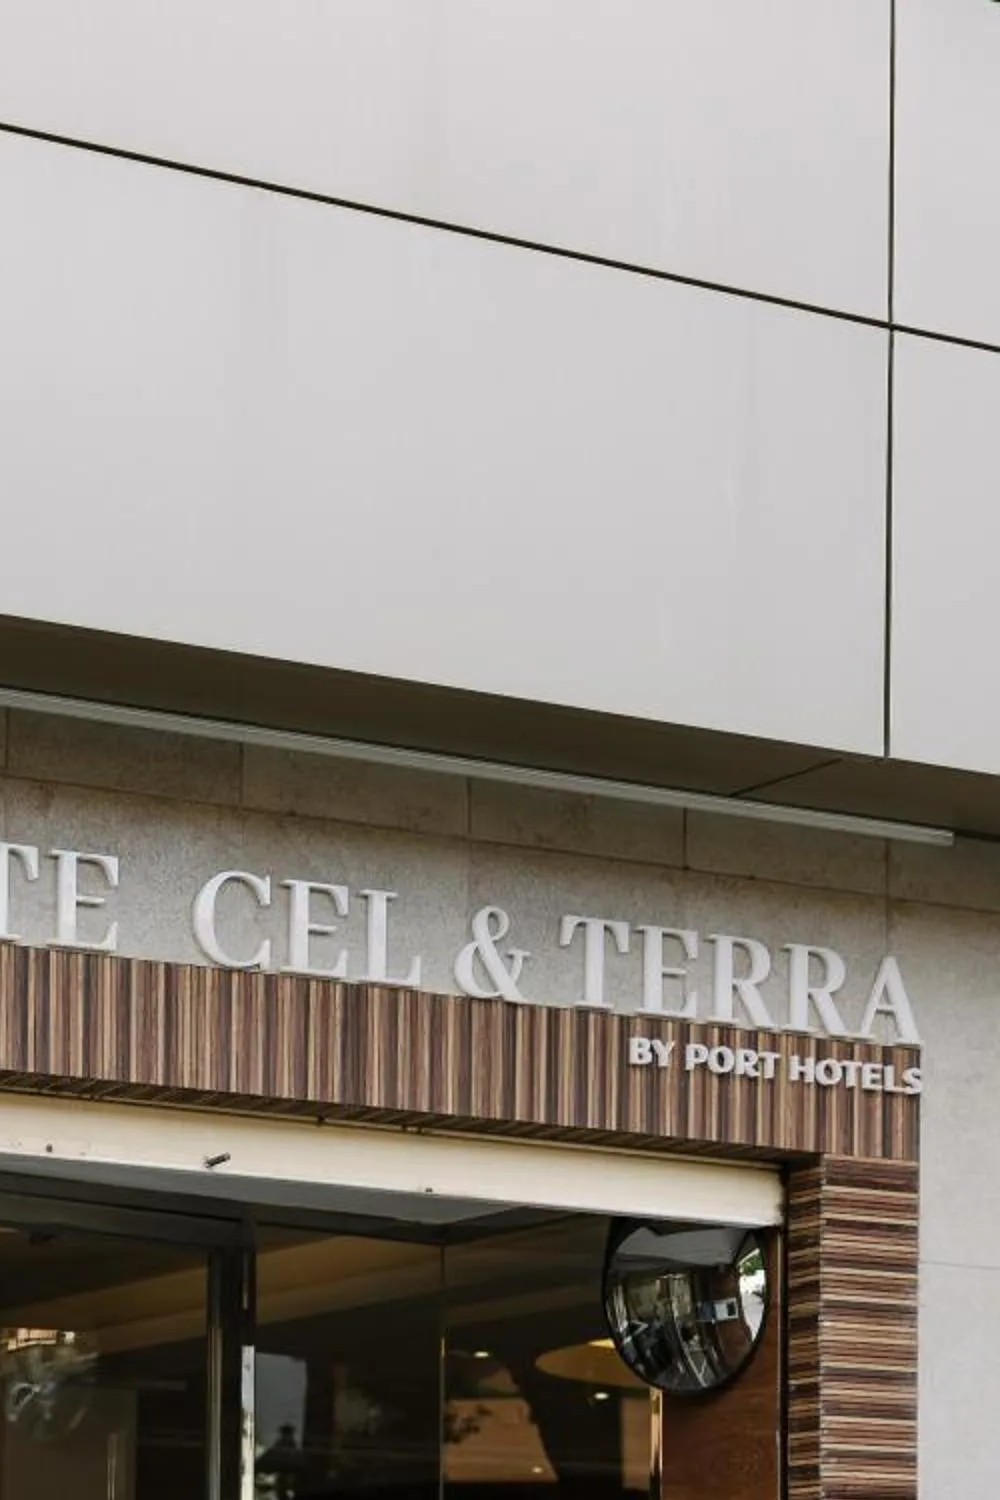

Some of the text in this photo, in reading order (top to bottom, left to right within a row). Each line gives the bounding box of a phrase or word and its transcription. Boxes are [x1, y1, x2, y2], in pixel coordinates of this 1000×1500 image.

[192, 870, 422, 988] CEL
[453, 905, 532, 1003] &
[559, 914, 922, 1047] TERRA
[629, 1036, 923, 1095] BY PORT HOTELS
